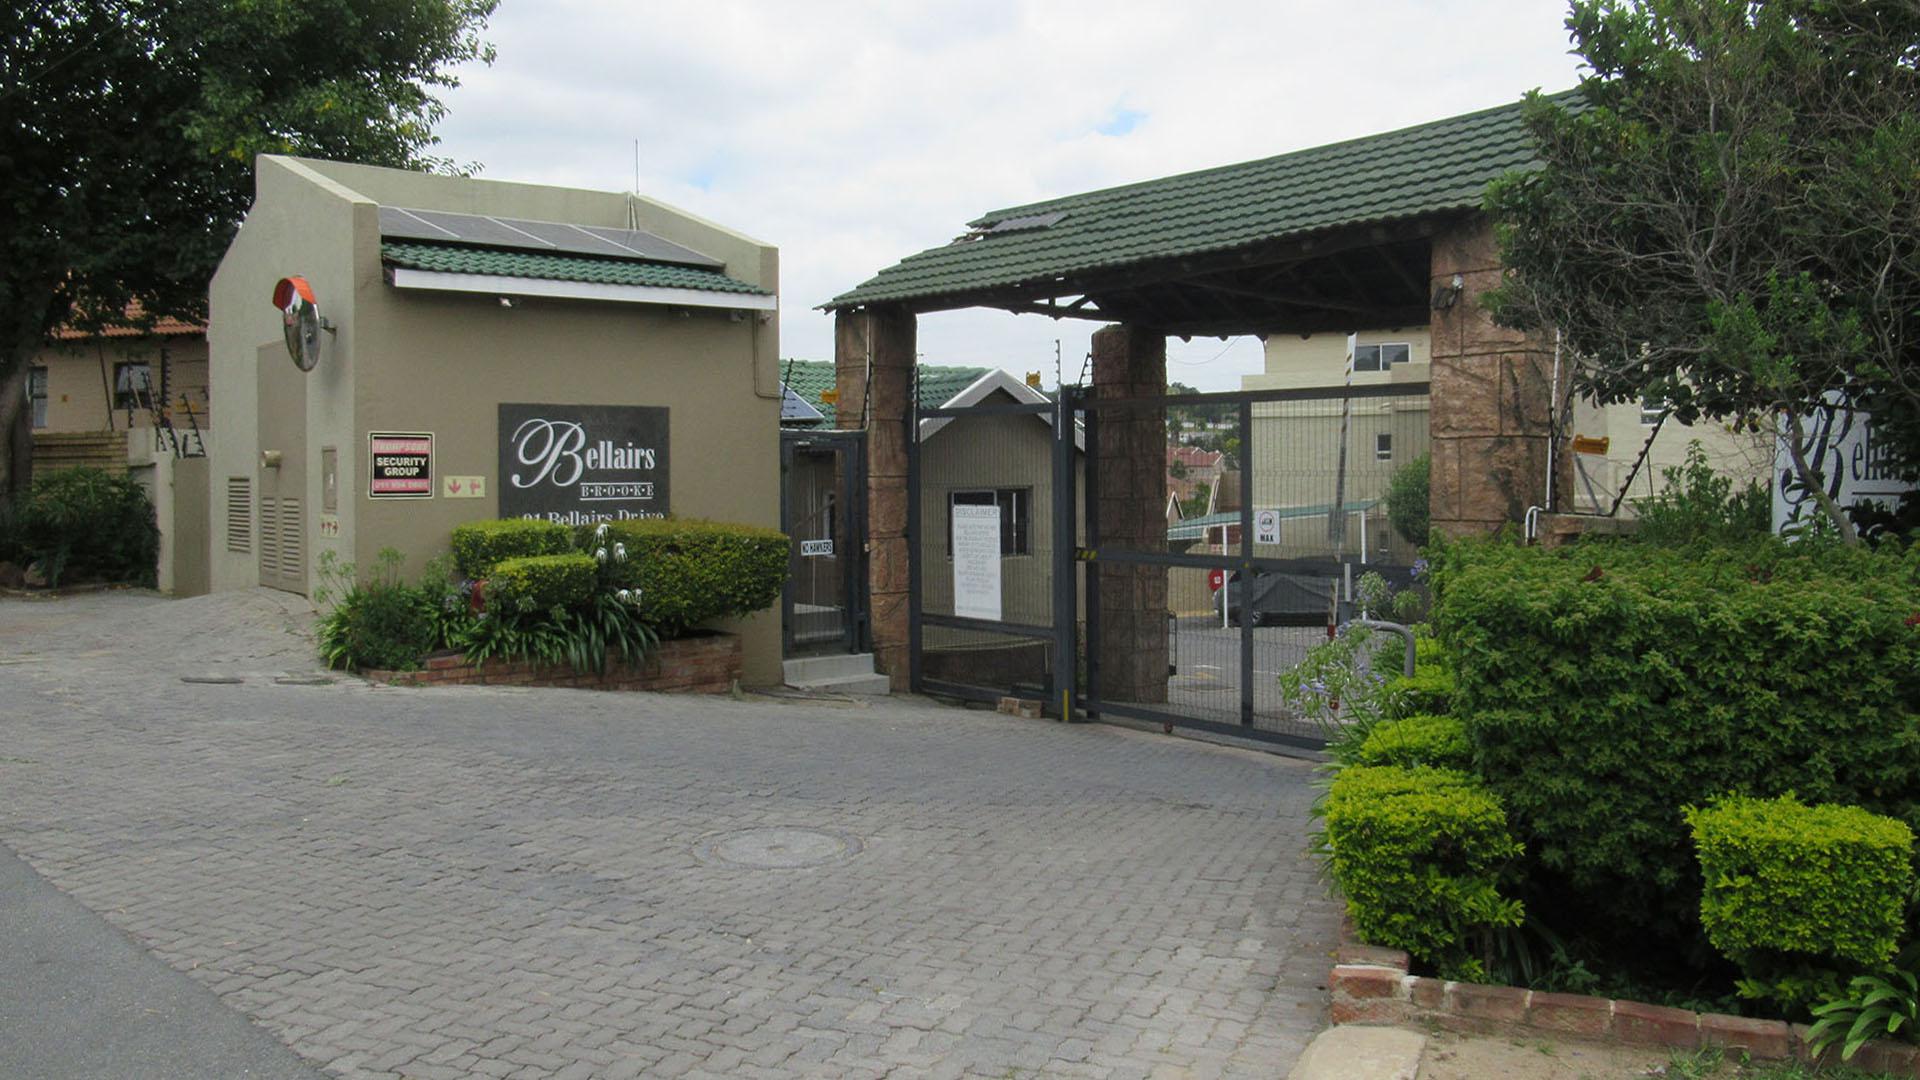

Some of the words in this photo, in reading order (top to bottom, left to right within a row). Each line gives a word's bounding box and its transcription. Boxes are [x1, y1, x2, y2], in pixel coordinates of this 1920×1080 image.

[511, 418, 656, 489] Bellairs
[376, 456, 427, 467] SECURITY
[384, 466, 420, 477] GROUP
[549, 510, 615, 526] Bellairs
[802, 542, 809, 554] NO
[810, 541, 832, 553] HAWKERS
